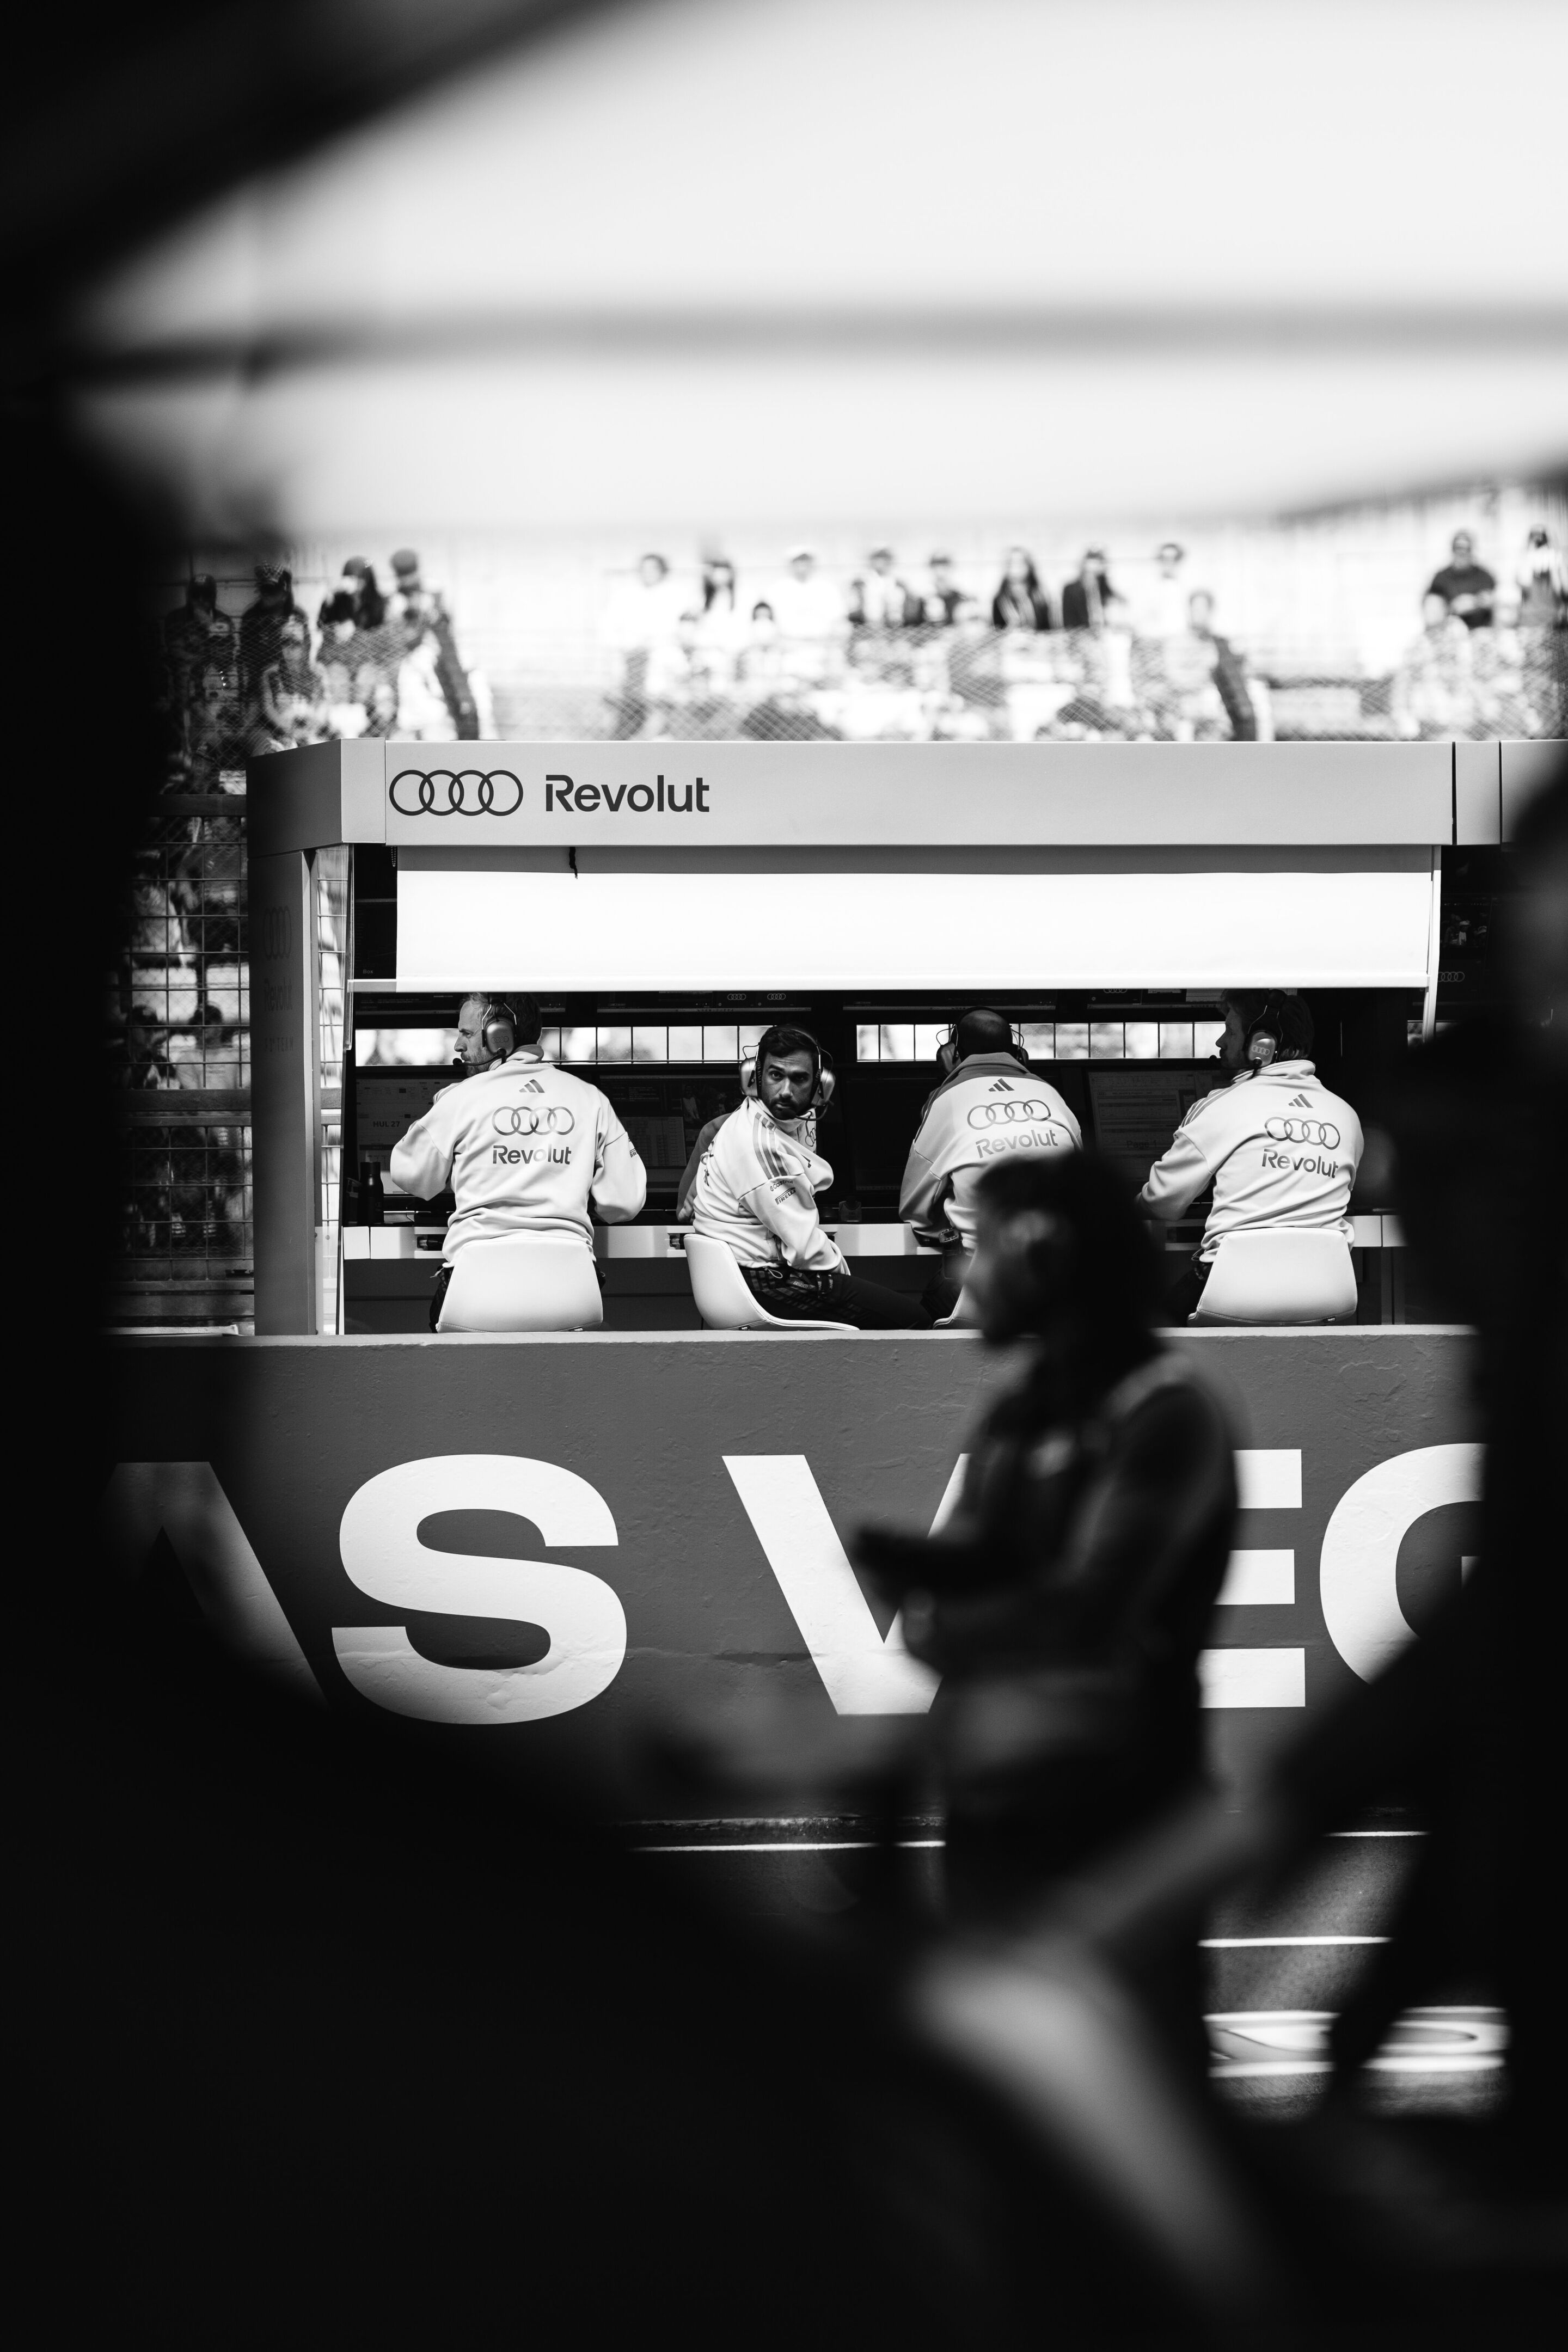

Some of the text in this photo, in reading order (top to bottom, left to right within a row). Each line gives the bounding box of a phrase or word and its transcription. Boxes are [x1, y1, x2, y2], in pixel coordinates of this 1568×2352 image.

[546, 774, 709, 812] Revolut
[264, 977, 292, 1011] Revolut
[493, 1144, 572, 1165] Revolut
[976, 1130, 1059, 1159] Revolut
[1126, 1140, 1150, 1150] Page
[1261, 1148, 1339, 1179] Revolut
